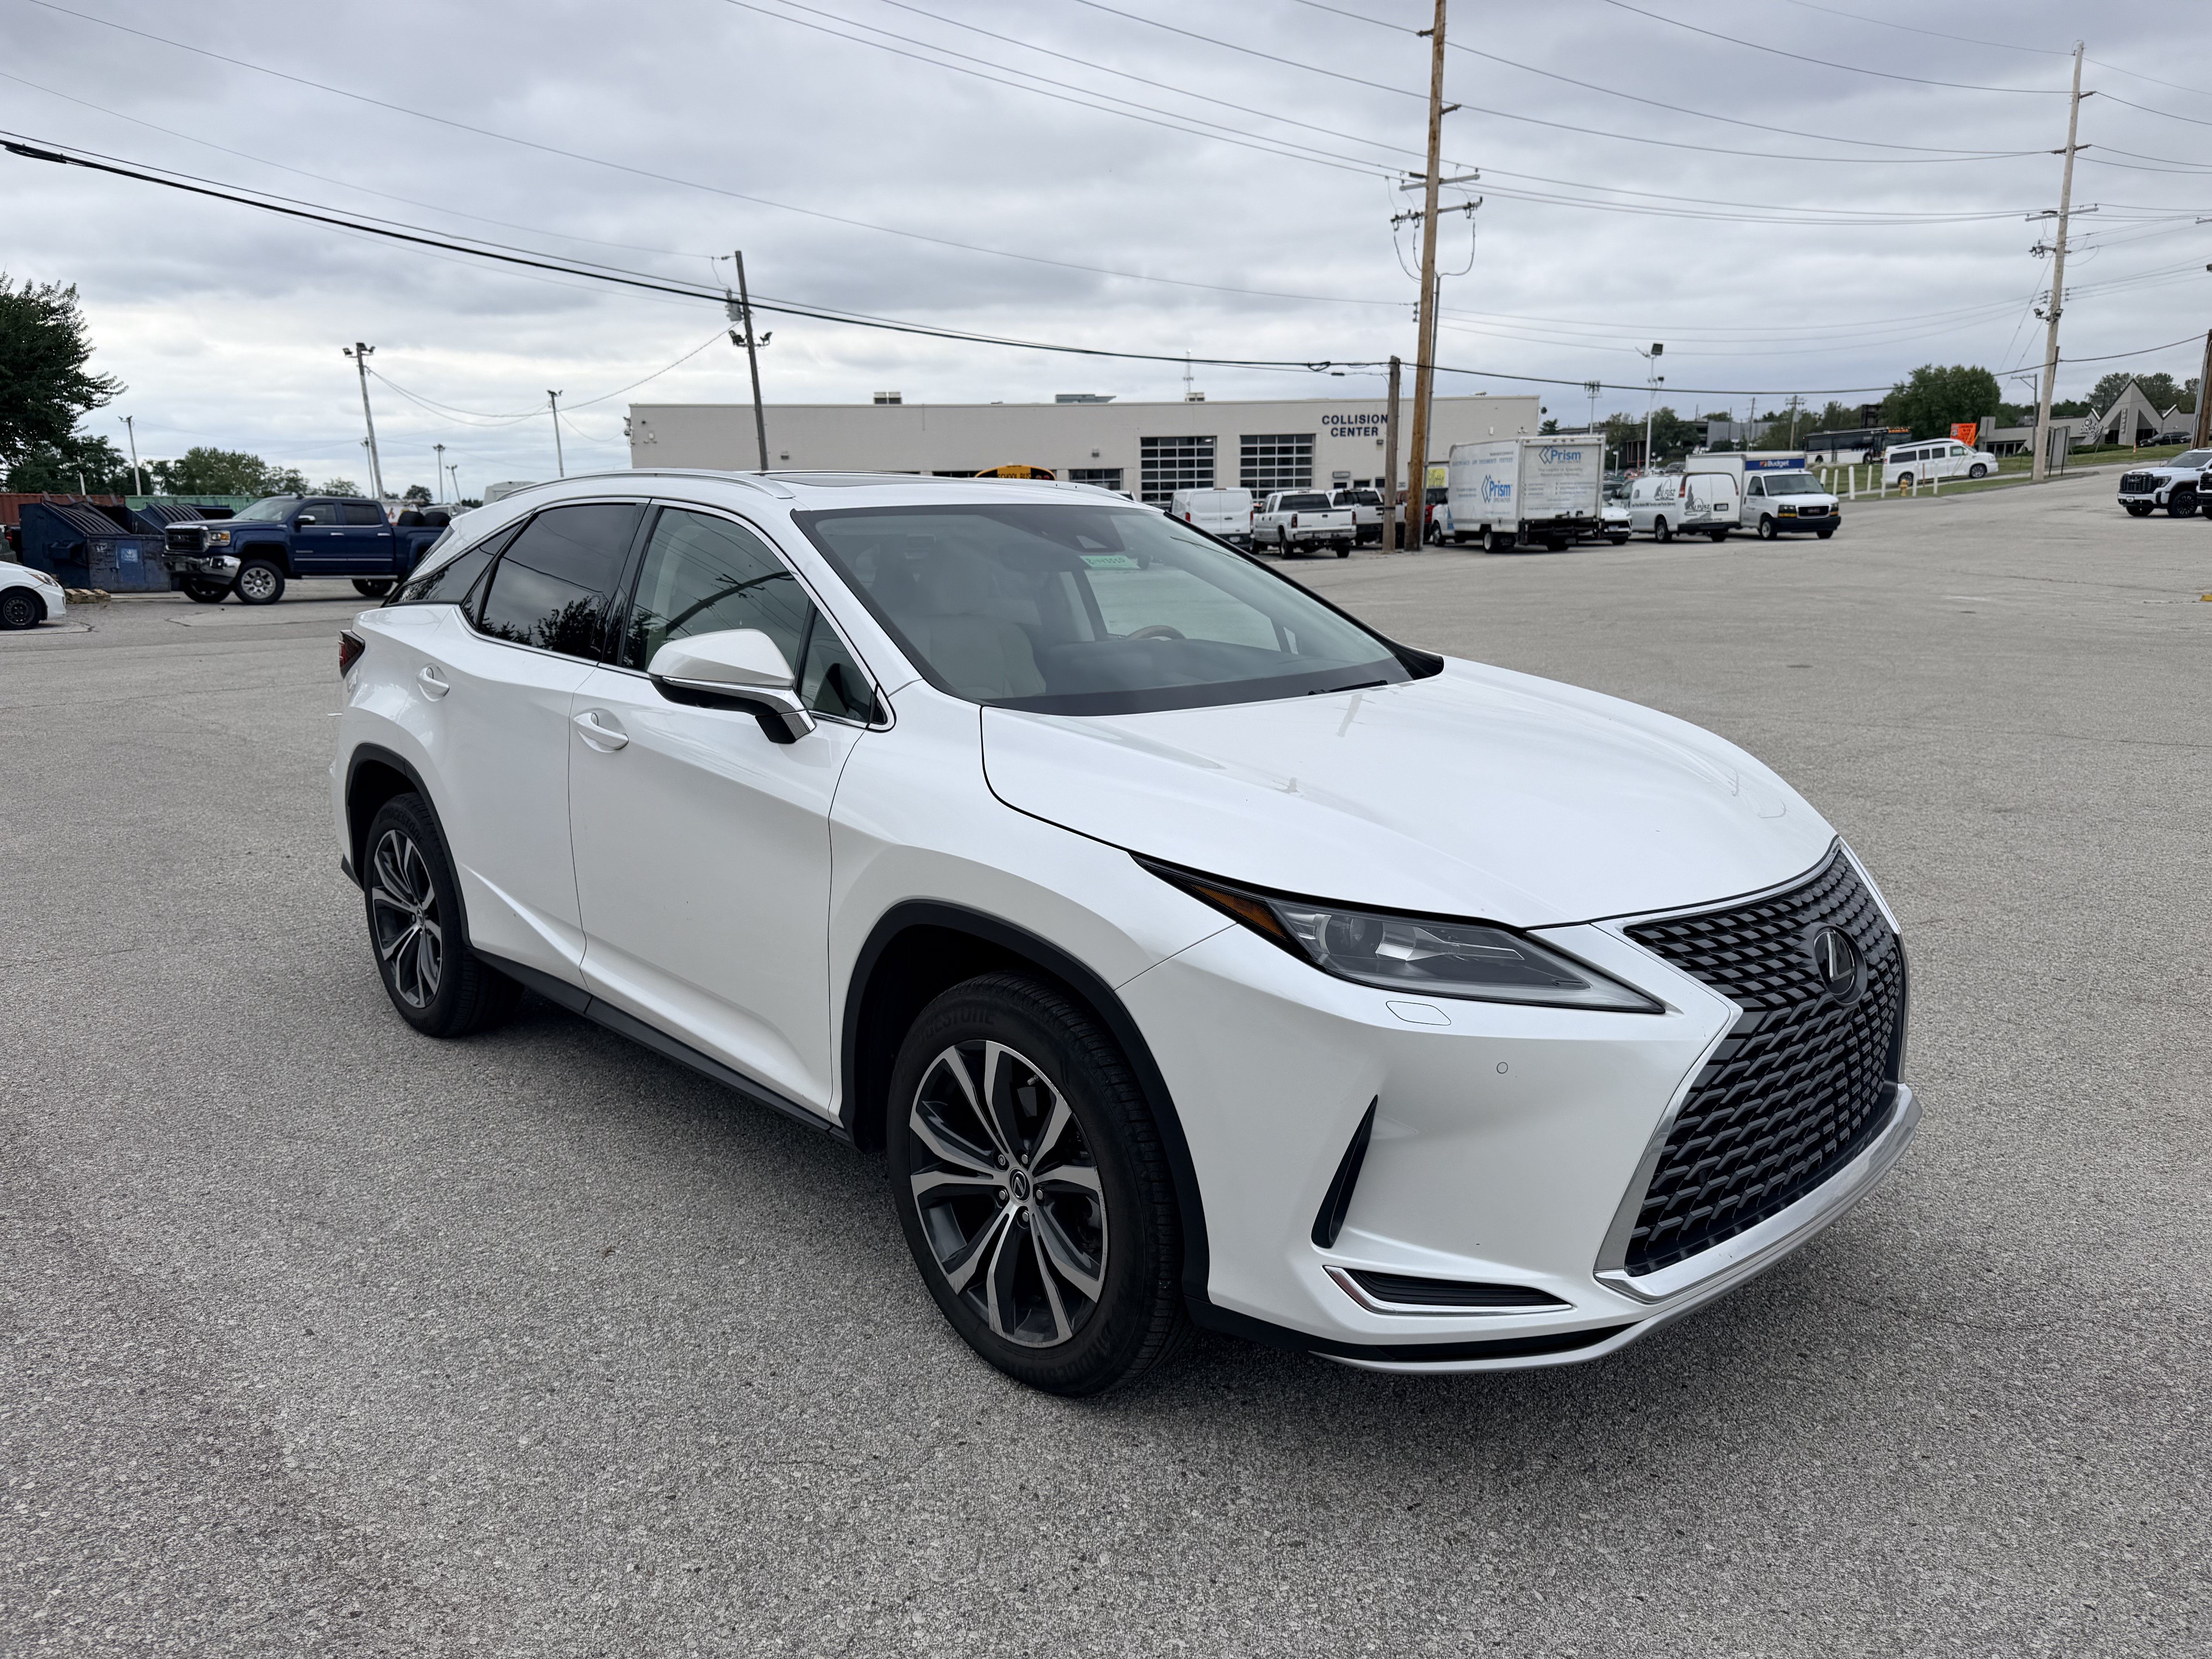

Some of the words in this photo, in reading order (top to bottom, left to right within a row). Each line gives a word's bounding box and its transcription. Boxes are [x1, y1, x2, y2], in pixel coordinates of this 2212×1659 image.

[1322, 414, 1388, 425] COLLISION
[1331, 427, 1378, 437] CENTER
[1551, 449, 1581, 460] Prism
[1767, 460, 1790, 468] Budget
[1490, 480, 1511, 497] Prism
